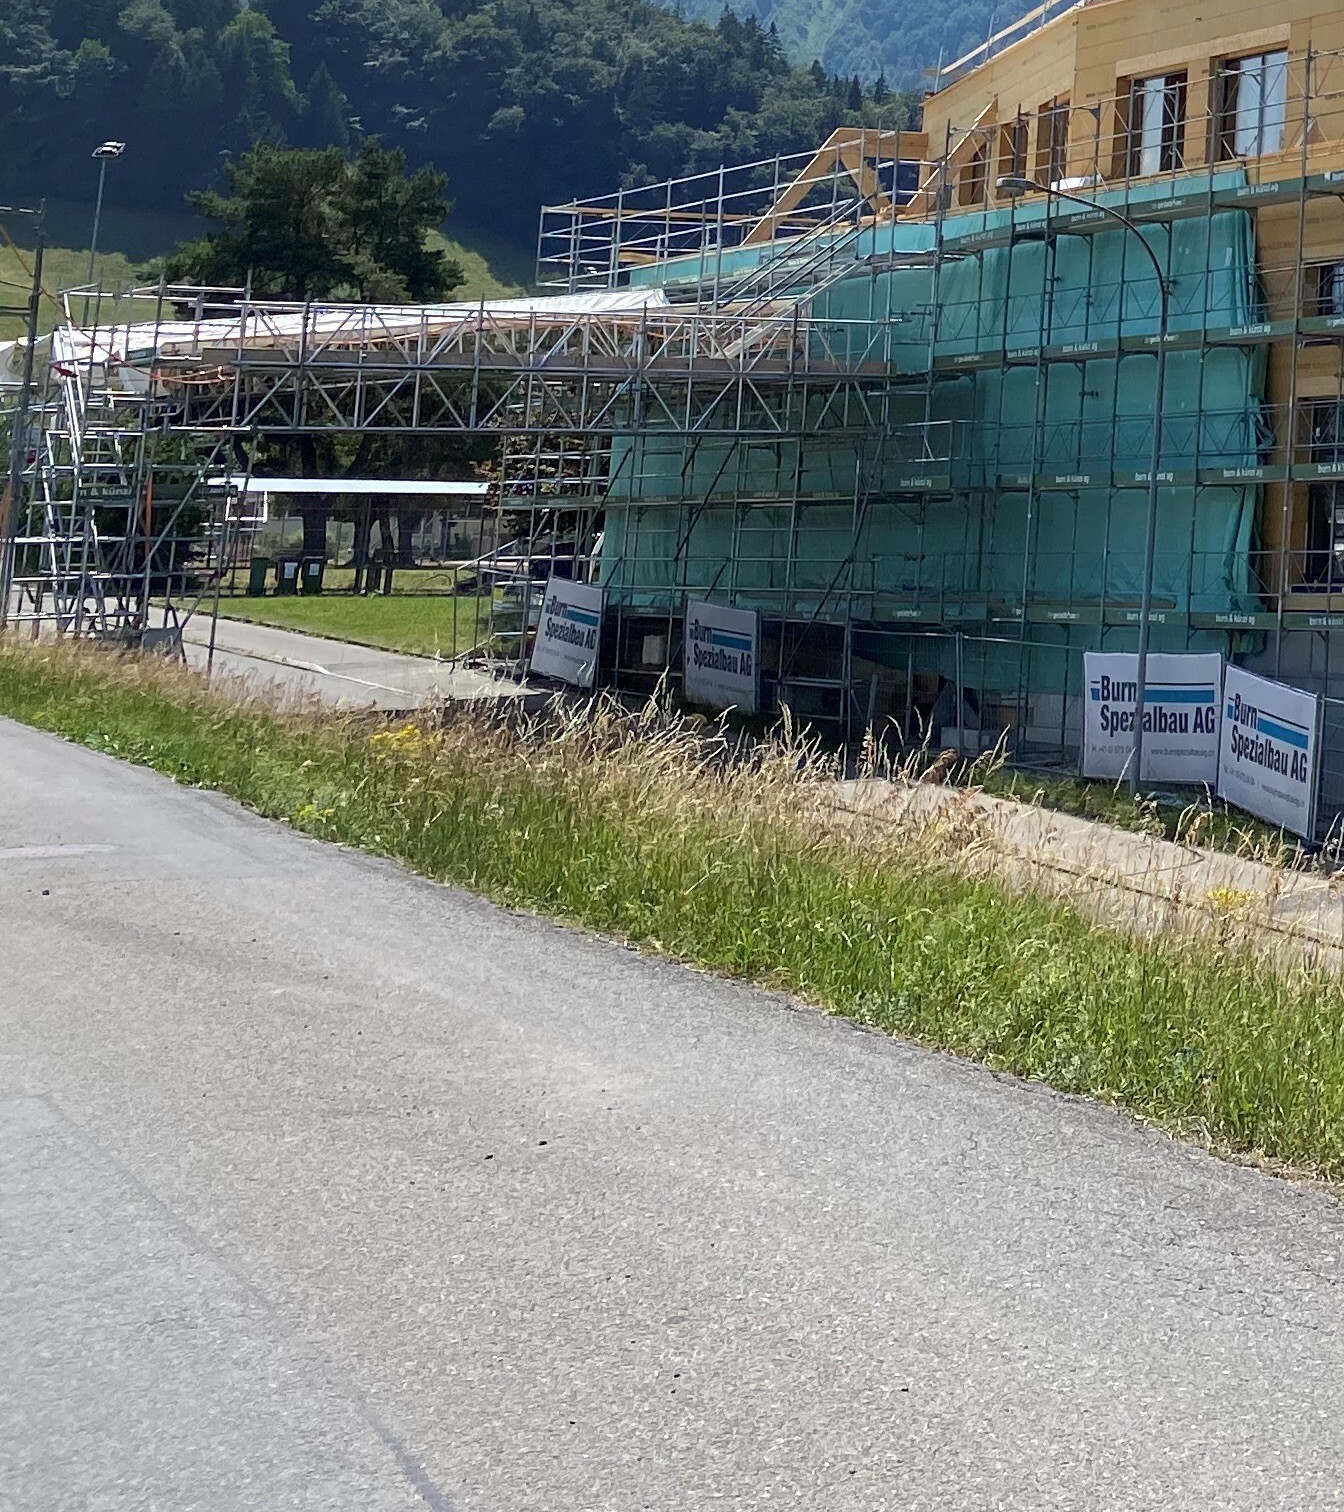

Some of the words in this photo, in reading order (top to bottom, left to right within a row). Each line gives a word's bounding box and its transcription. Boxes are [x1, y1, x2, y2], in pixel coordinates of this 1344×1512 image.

[551, 595, 568, 618] Burn
[544, 616, 585, 647] Spezialbau
[585, 628, 597, 650] AG
[694, 618, 713, 643] Burn
[693, 642, 738, 671] Spezialbau
[740, 651, 752, 676] AG
[1100, 675, 1137, 702] Burn
[1100, 704, 1189, 738] Spezalbau
[1193, 706, 1216, 734] AG
[1233, 693, 1258, 730] Burn
[1231, 724, 1289, 775] Spezialbau
[1290, 750, 1308, 784] AG
